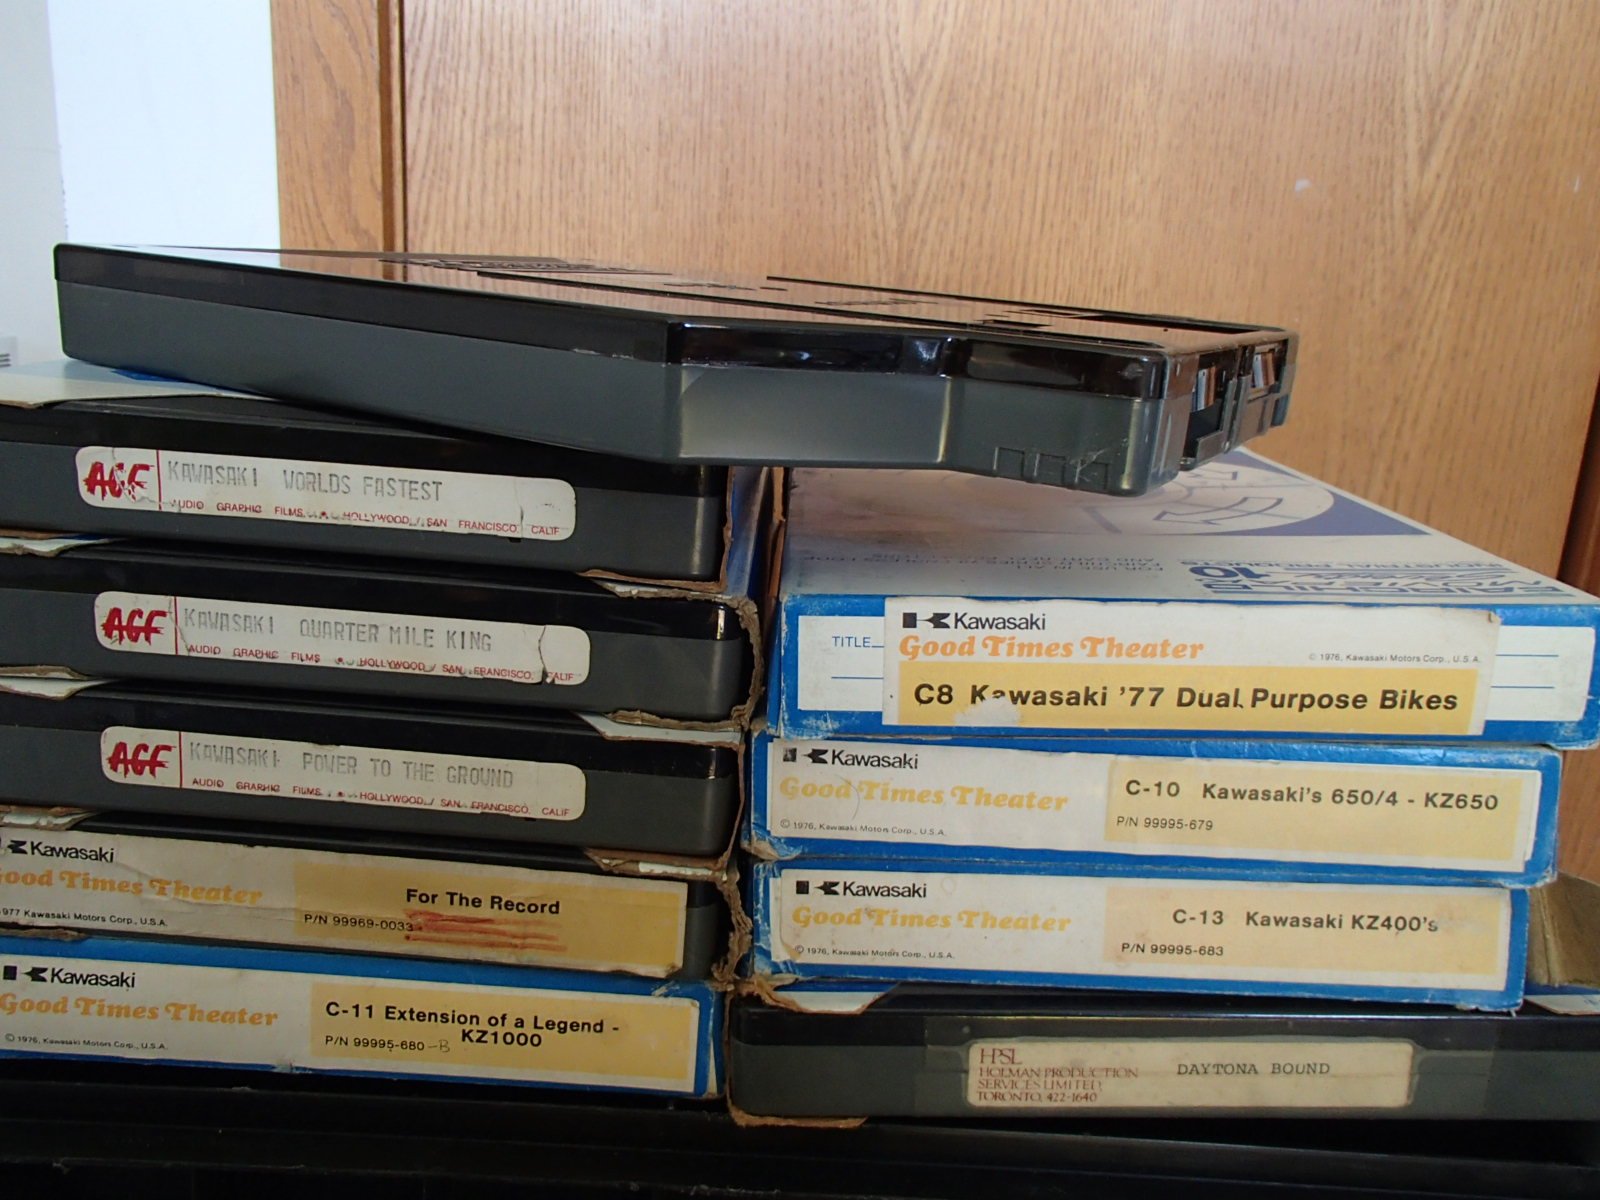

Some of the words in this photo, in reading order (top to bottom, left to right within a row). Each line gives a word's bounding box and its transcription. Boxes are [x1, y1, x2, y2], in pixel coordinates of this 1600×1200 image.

[168, 460, 257, 487] KAWASAKI
[282, 469, 351, 495] WORLDS
[363, 476, 442, 501] FASTEST
[217, 502, 262, 514] GRAPHIC
[344, 512, 409, 524] HOLLYWOOD
[427, 517, 447, 527] SAN
[1188, 566, 1268, 579] 10
[184, 608, 273, 634] KAWASAKI
[300, 617, 379, 643] QUARTER
[389, 626, 434, 648] MILE
[447, 630, 491, 651] KING
[954, 612, 1045, 631] Kawasaki
[832, 636, 871, 648] TITLE
[899, 635, 976, 661] Good
[982, 636, 1073, 659] Times
[1080, 636, 1204, 660] Theater
[189, 644, 221, 655] AUDIO
[233, 648, 278, 660] GRAPHIC
[291, 652, 320, 663] FILMS
[360, 658, 425, 672] HOLLYWOOD
[442, 664, 463, 674] SAN
[1346, 654, 1387, 662] Kawasaki
[1390, 654, 1421, 662] Motors
[914, 684, 954, 705] C8
[1118, 686, 1165, 707] '77
[1251, 688, 1367, 712] Purpose
[1379, 689, 1457, 710] Bikes
[190, 742, 278, 768] KAWASAKI
[303, 751, 357, 775] POWER
[370, 758, 391, 777] TO
[403, 761, 434, 783] THE
[447, 766, 513, 788] GROUND
[831, 750, 918, 769] Kawasaki
[192, 777, 224, 788] AUDIO
[236, 781, 280, 792] GRAPHIC
[293, 785, 322, 796] FILMS
[360, 791, 423, 805] HOLLYWOOD
[440, 798, 461, 808] SAN
[542, 807, 570, 816] CALIF
[780, 777, 850, 800] Good
[857, 780, 944, 804] Times
[950, 785, 1069, 811] Theater
[1126, 780, 1181, 797] C-10
[1202, 783, 1322, 804] Kawasaki's
[1331, 789, 1399, 807] 650/4
[1424, 792, 1498, 811] KZ650
[819, 823, 857, 832] Kawasaki
[860, 825, 889, 833] Motors
[1117, 815, 1138, 828] P/N
[1143, 816, 1213, 831] 99995-679
[30, 841, 115, 863] Kawasaki
[59, 870, 143, 896] Times
[149, 878, 262, 904] Theater
[842, 881, 927, 898] Kawasaki
[406, 889, 438, 905] For
[446, 892, 482, 908] The
[490, 896, 560, 915] Record
[24, 910, 70, 920] Kawasaki
[74, 913, 106, 923] Motors
[304, 914, 328, 927] P/N
[792, 906, 861, 929] Good
[866, 908, 951, 929] Times
[957, 911, 1072, 932] Theater
[1173, 909, 1224, 925] C-13
[1246, 911, 1344, 930] Kawasaki
[1351, 914, 1439, 933] KZ400's
[832, 949, 869, 957] Kawasaki
[871, 950, 900, 958] Motors
[1121, 942, 1145, 954] P/N
[1150, 943, 1224, 957] 99995-683
[51, 968, 136, 988] Kawasaki
[0, 993, 69, 1016] Good
[74, 997, 159, 1020] Times
[164, 1002, 278, 1026] Theater
[326, 1002, 374, 1019] C-11
[385, 1006, 480, 1027] Extension
[487, 1012, 507, 1028] of
[514, 1017, 526, 1030] a
[534, 1015, 605, 1034] Legend
[43, 1038, 81, 1046] Kawasaki
[325, 1035, 349, 1047] P/N
[353, 1036, 425, 1052] 99995-680
[461, 1029, 542, 1048] KZ1000
[979, 1067, 1040, 1078] HOLMAN
[1045, 1067, 1139, 1079] PRODUCTION
[1177, 1063, 1258, 1076] DAYTONA
[1271, 1062, 1330, 1075] BOUND
[978, 1079, 1040, 1090] SERVICES
[1047, 1092, 1097, 1102] 422-1640
